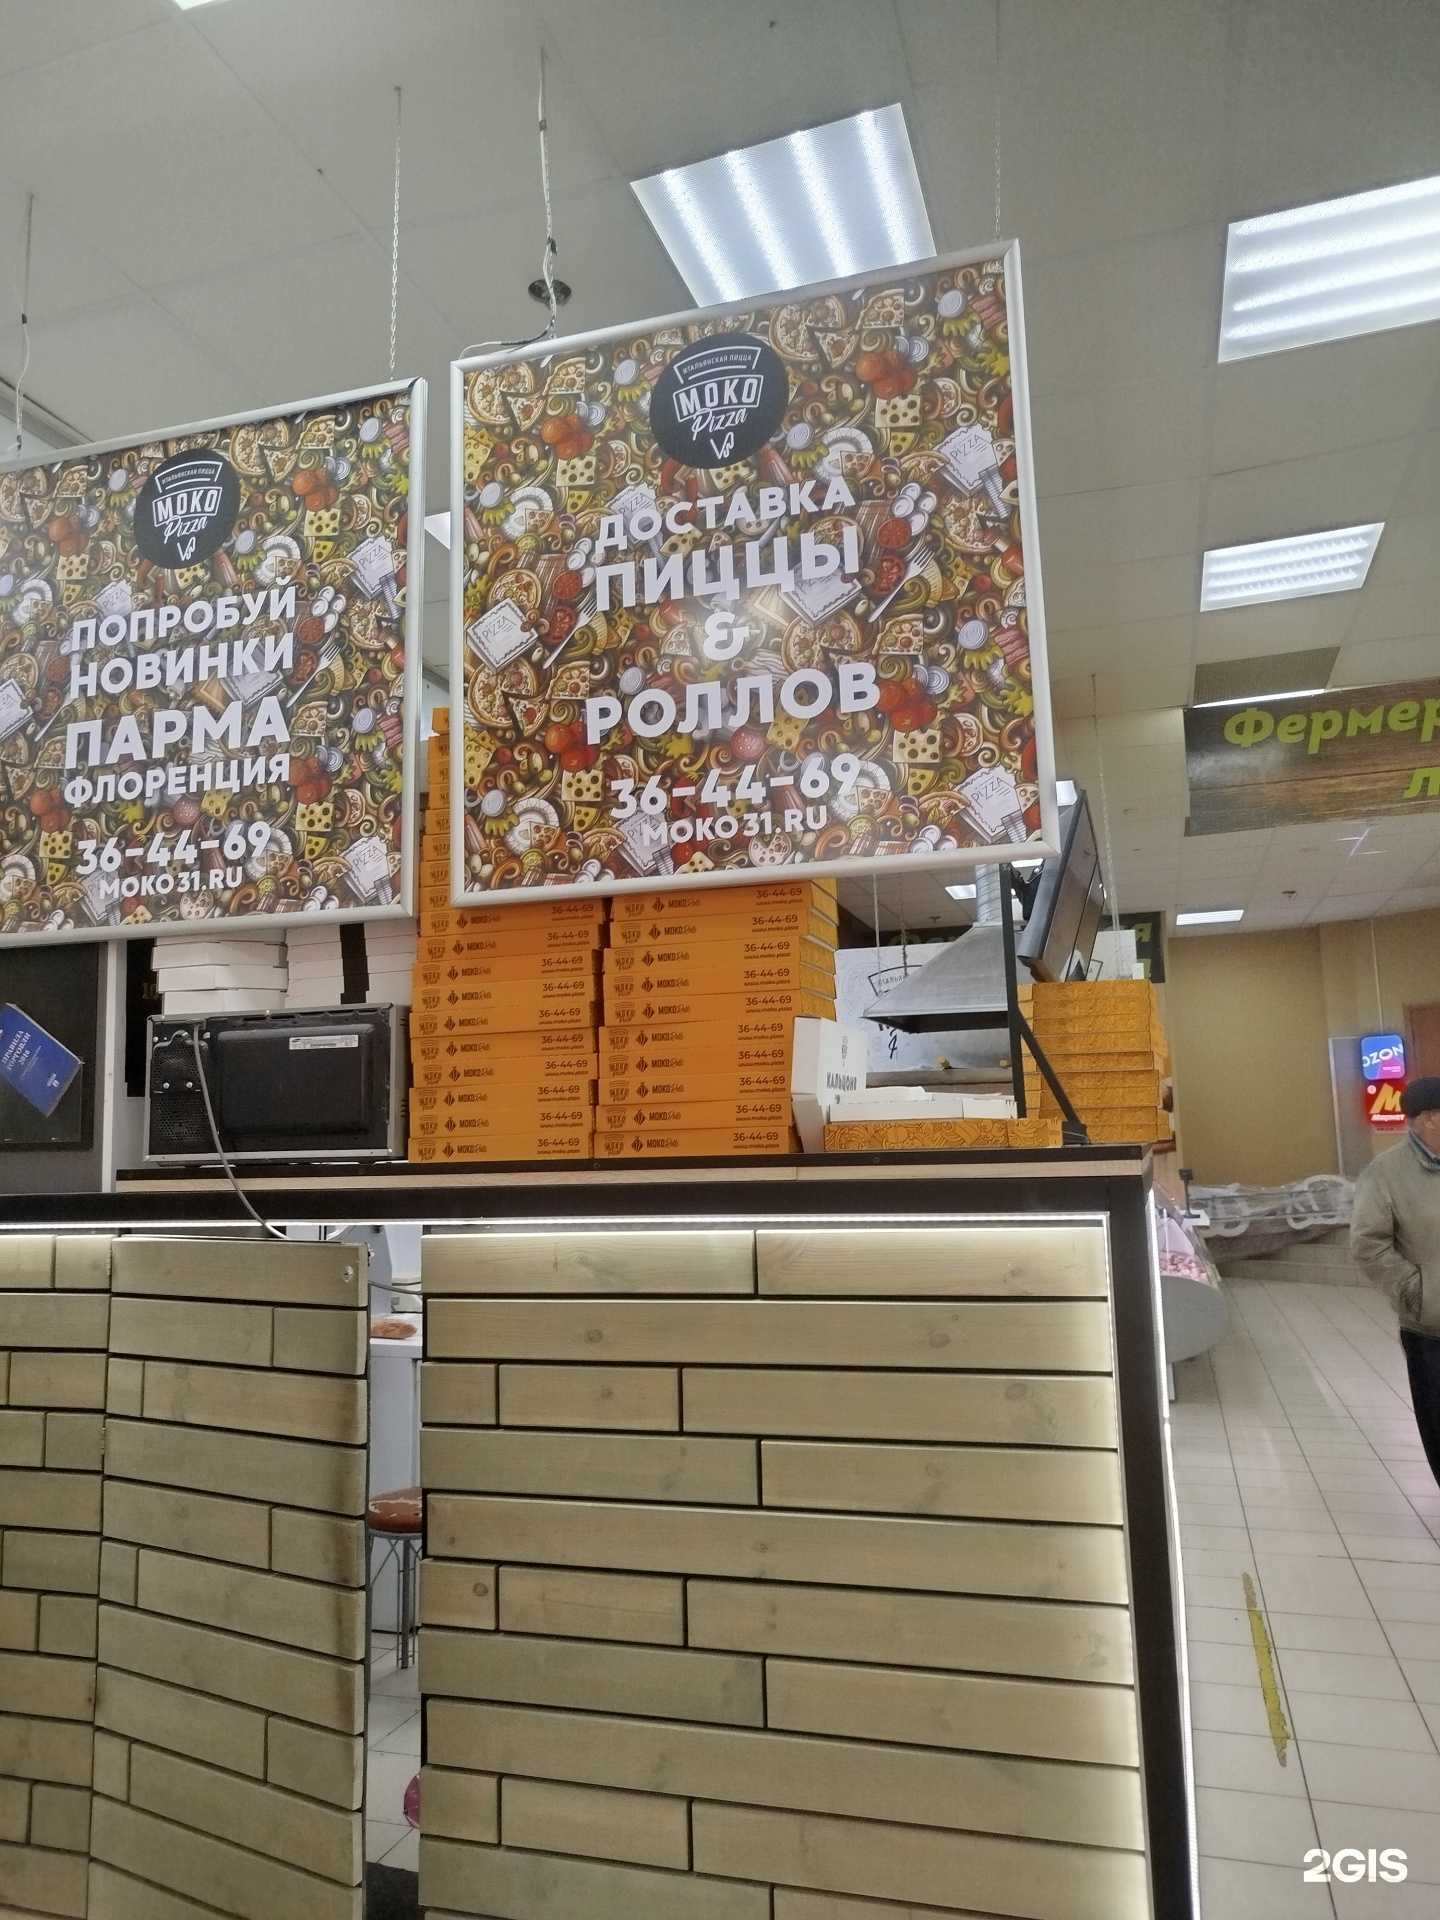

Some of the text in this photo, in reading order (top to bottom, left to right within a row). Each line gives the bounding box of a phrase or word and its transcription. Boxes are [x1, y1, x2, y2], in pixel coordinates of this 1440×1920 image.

[678, 378, 759, 417] MOKO
[691, 407, 748, 441] Pizza
[156, 488, 218, 523] MOKO
[595, 475, 856, 554] ДОСТАВКА
[163, 515, 208, 544] Pizza
[596, 525, 860, 612] ПИЦЦЫ
[71, 576, 297, 651] ПОПРОБУЙ
[702, 611, 750, 661] &
[69, 632, 294, 699] НОВИНКИ
[585, 661, 881, 745] РОЛЛОВ
[64, 695, 291, 770] ПАРМА
[63, 752, 291, 808] ФЛОРЕНЦИЯ
[610, 752, 861, 819] 36-44-69
[643, 805, 828, 848] MOKO31.RU
[75, 821, 271, 875] 36-44-69
[99, 866, 243, 900] MOKO31.RU
[752, 914, 798, 925] 36-44-69
[744, 941, 790, 952] 36-44-69
[744, 968, 790, 979] 36-44-69
[745, 995, 792, 1006] 36-44-69
[737, 1023, 784, 1034] 36-44-69
[738, 1049, 784, 1060] 36-44-69
[739, 1075, 785, 1086] 36-44-69
[735, 1104, 782, 1114] 36-44-69
[733, 1131, 779, 1142] 36-44-69
